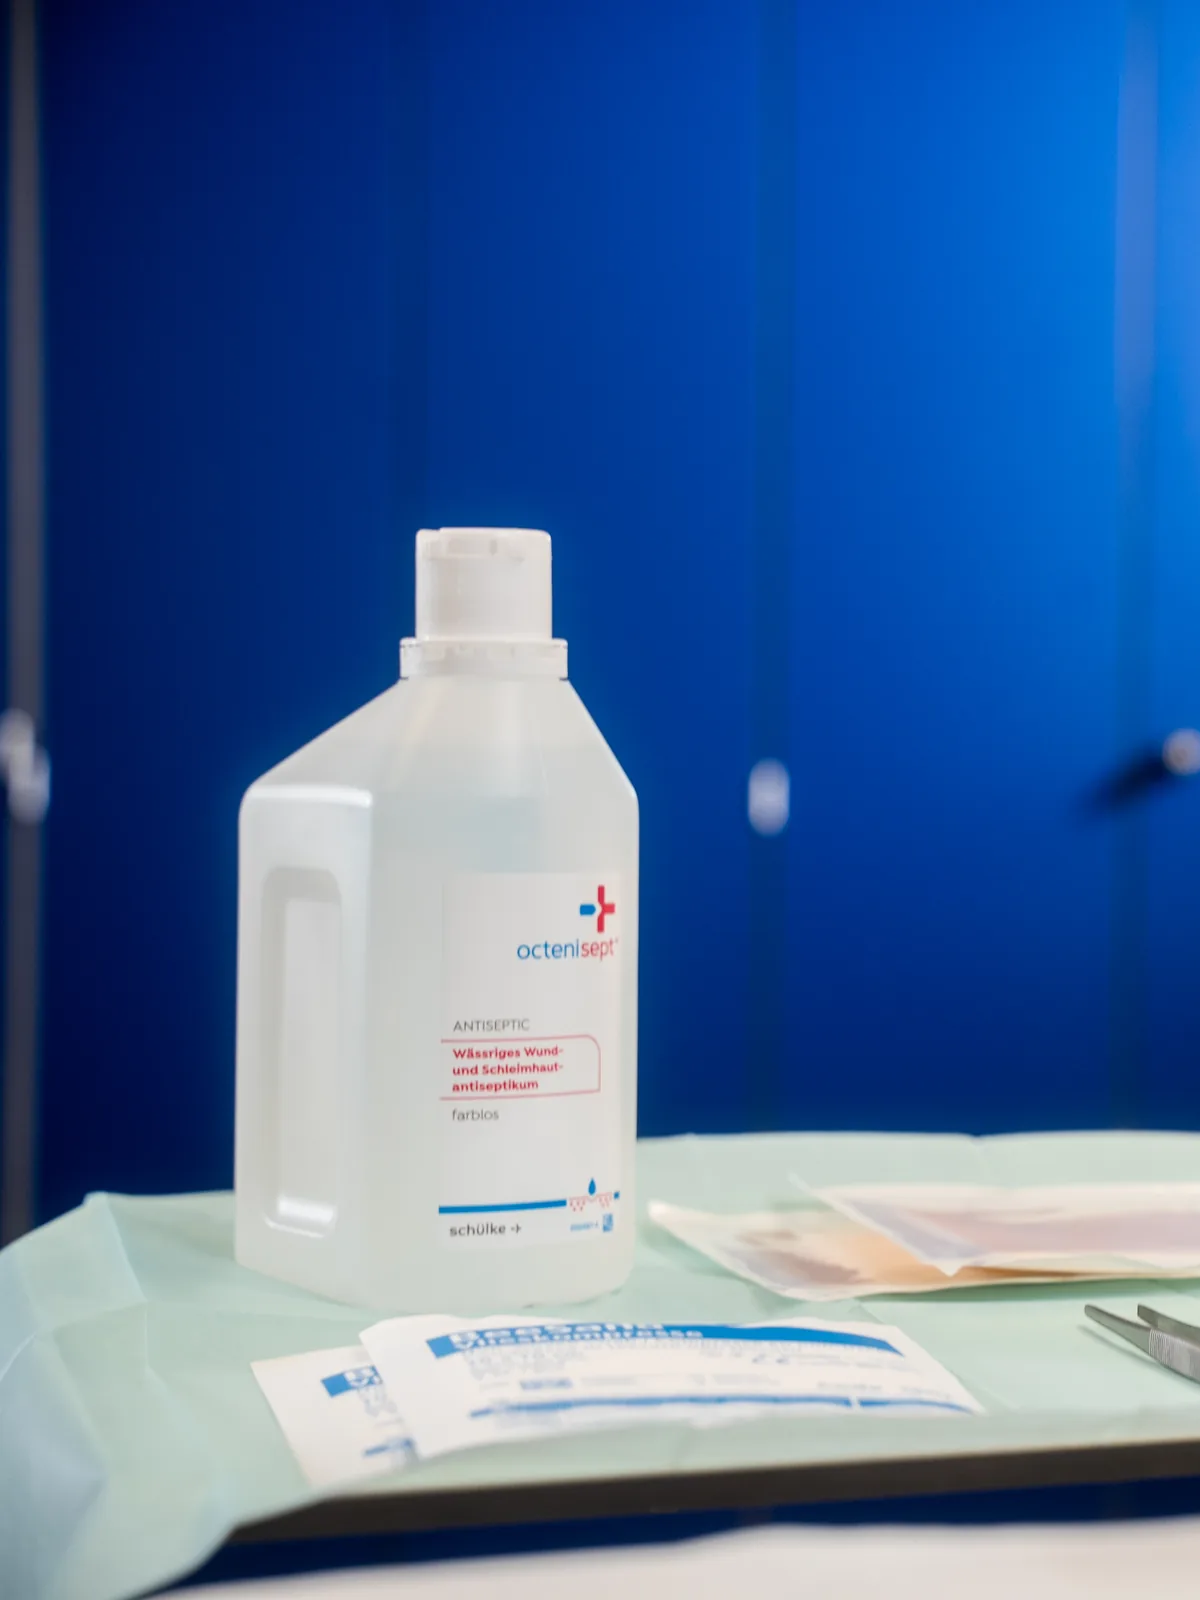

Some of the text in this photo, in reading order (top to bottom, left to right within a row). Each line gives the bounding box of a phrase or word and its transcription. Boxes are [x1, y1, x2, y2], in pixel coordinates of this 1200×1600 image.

[516, 938, 615, 961] octenisept
[453, 1018, 530, 1032] ANTISEPTIC
[452, 1044, 564, 1060] Wässriges Wund-
[452, 1061, 564, 1076] und Schleimhaut-
[452, 1079, 539, 1093] antiseptikum
[452, 1108, 500, 1121] farblos
[449, 1222, 506, 1237] schülke
